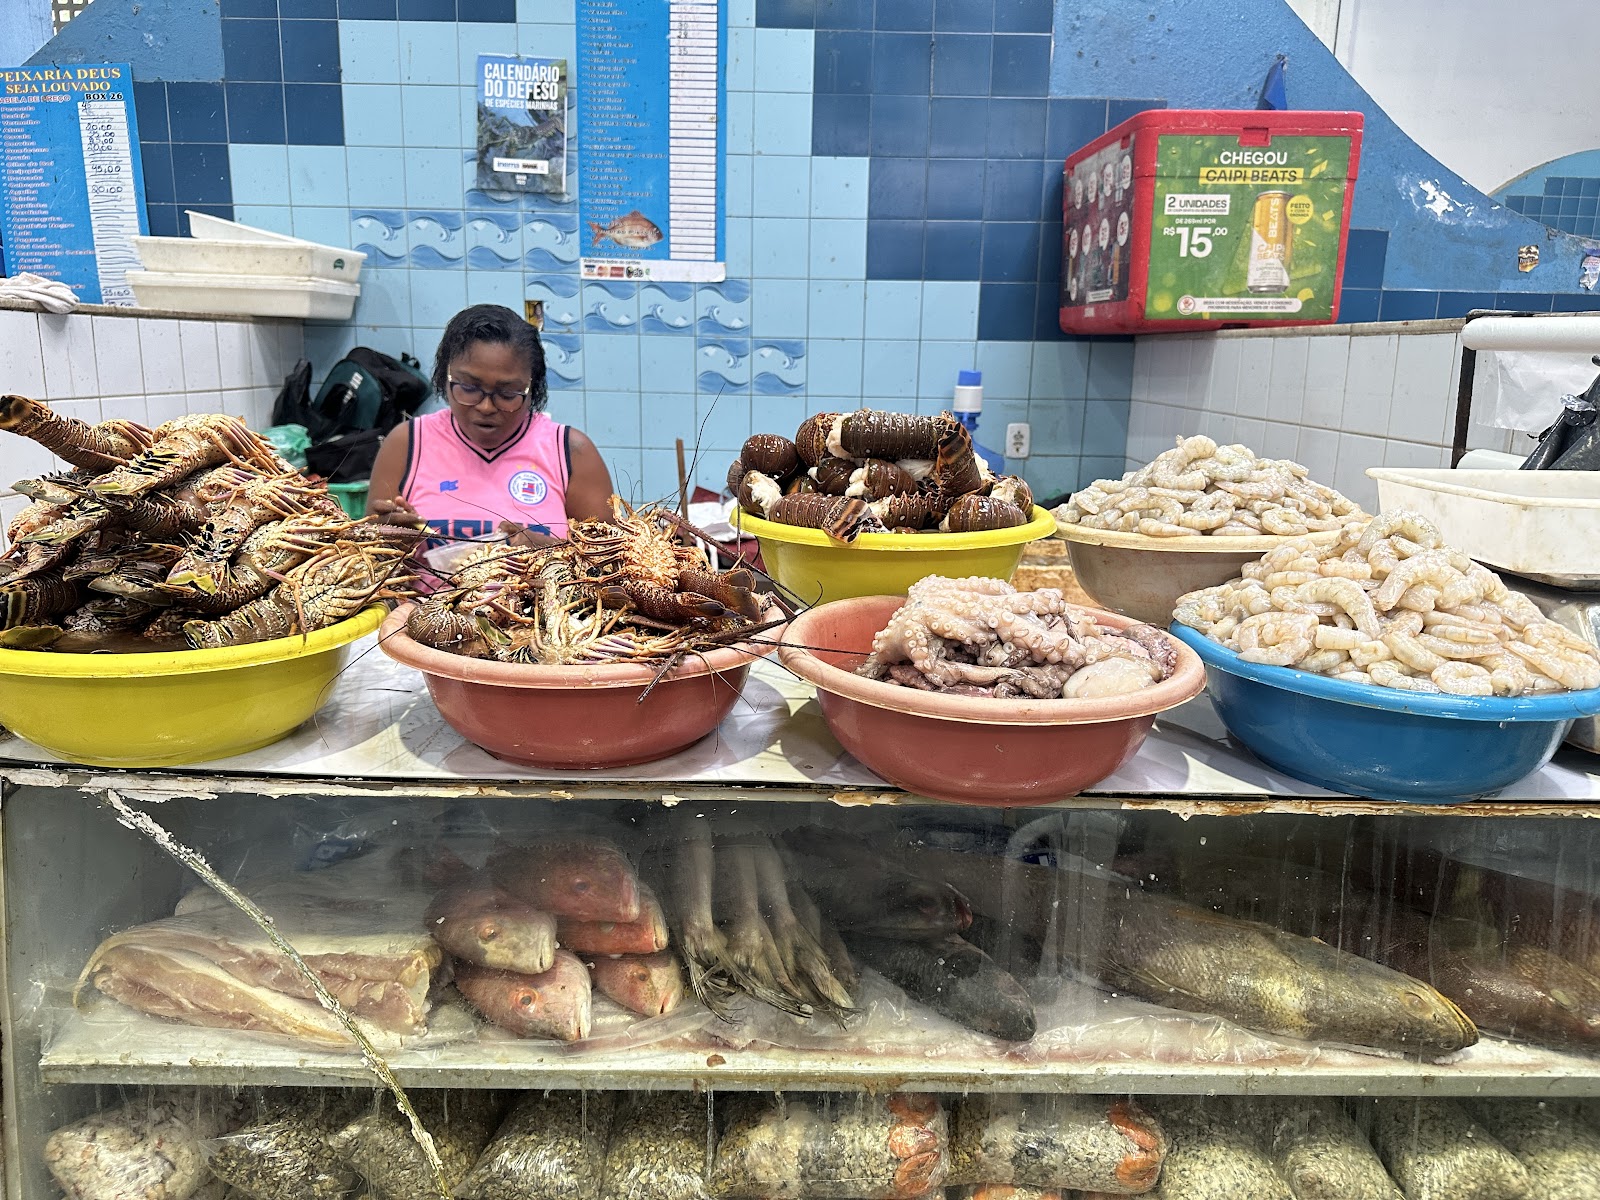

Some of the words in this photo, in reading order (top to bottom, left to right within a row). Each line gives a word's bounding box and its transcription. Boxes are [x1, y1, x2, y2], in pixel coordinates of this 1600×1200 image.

[77, 68, 121, 80] DEUS
[484, 63, 560, 82] CALENDÁRIO
[6, 84, 39, 94] SEJA
[42, 81, 111, 93] LOUVADO
[484, 80, 503, 97] DO
[507, 81, 559, 100] DEFESO
[85, 92, 107, 101] BOX
[110, 92, 124, 101] 26
[485, 98, 494, 108] DE
[495, 98, 525, 109] ESPÉCIES
[526, 100, 558, 111] MARINHAS
[1220, 151, 1288, 165] CHEGOU
[1205, 169, 1247, 183] CAIPI
[1250, 169, 1298, 183] BEATS
[1168, 196, 1176, 208] 2
[1179, 199, 1227, 208] UNIDADES
[1268, 197, 1280, 238] BEATS
[1163, 227, 1175, 237] R$
